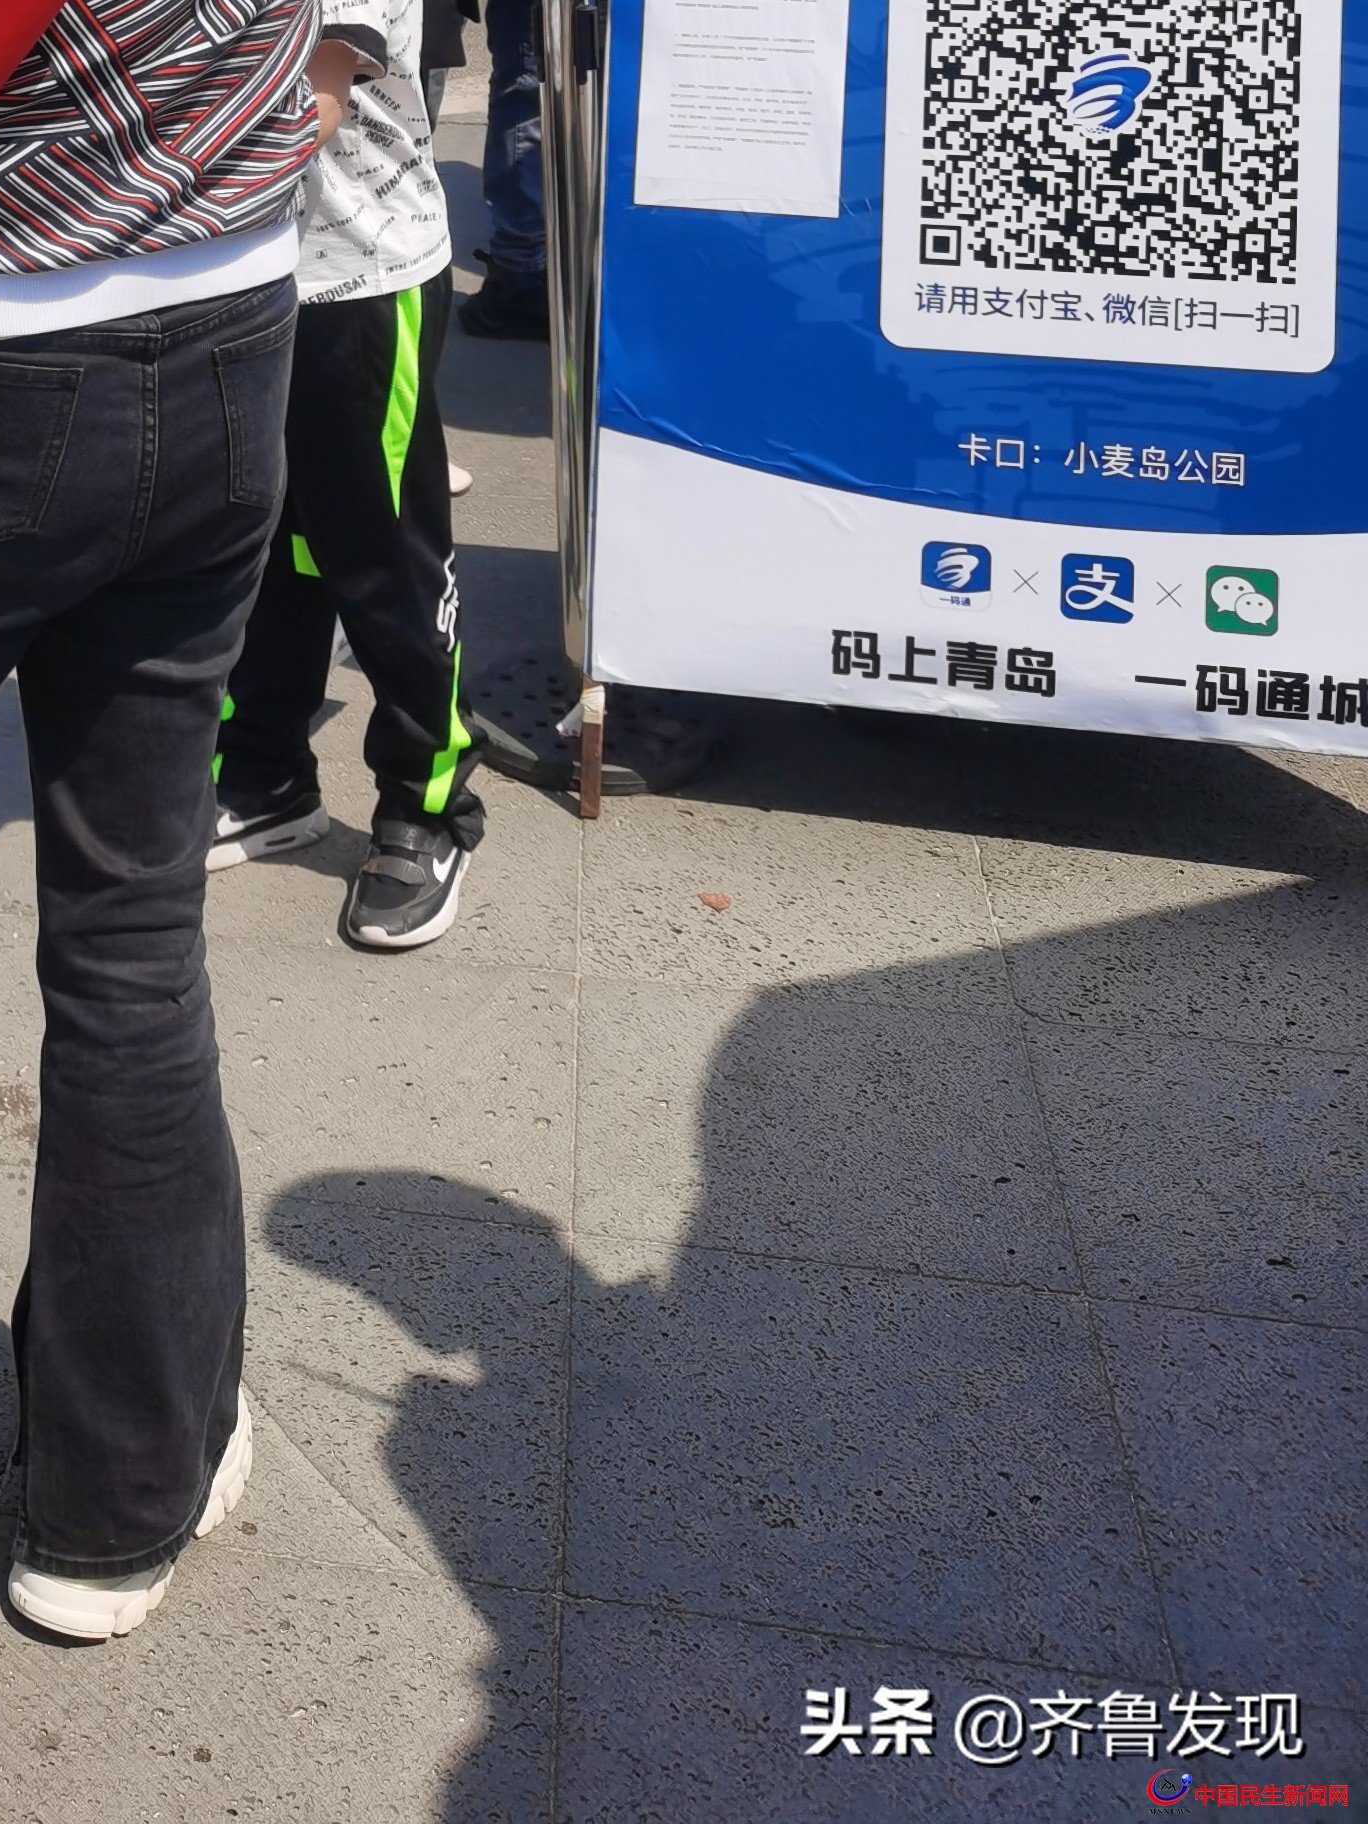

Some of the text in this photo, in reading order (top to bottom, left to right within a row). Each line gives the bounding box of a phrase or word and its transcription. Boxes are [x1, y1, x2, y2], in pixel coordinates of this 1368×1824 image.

[938, 596, 972, 607] 一码通
[830, 628, 1057, 698] 码上青岛
[1134, 663, 1368, 727] 一码通城
